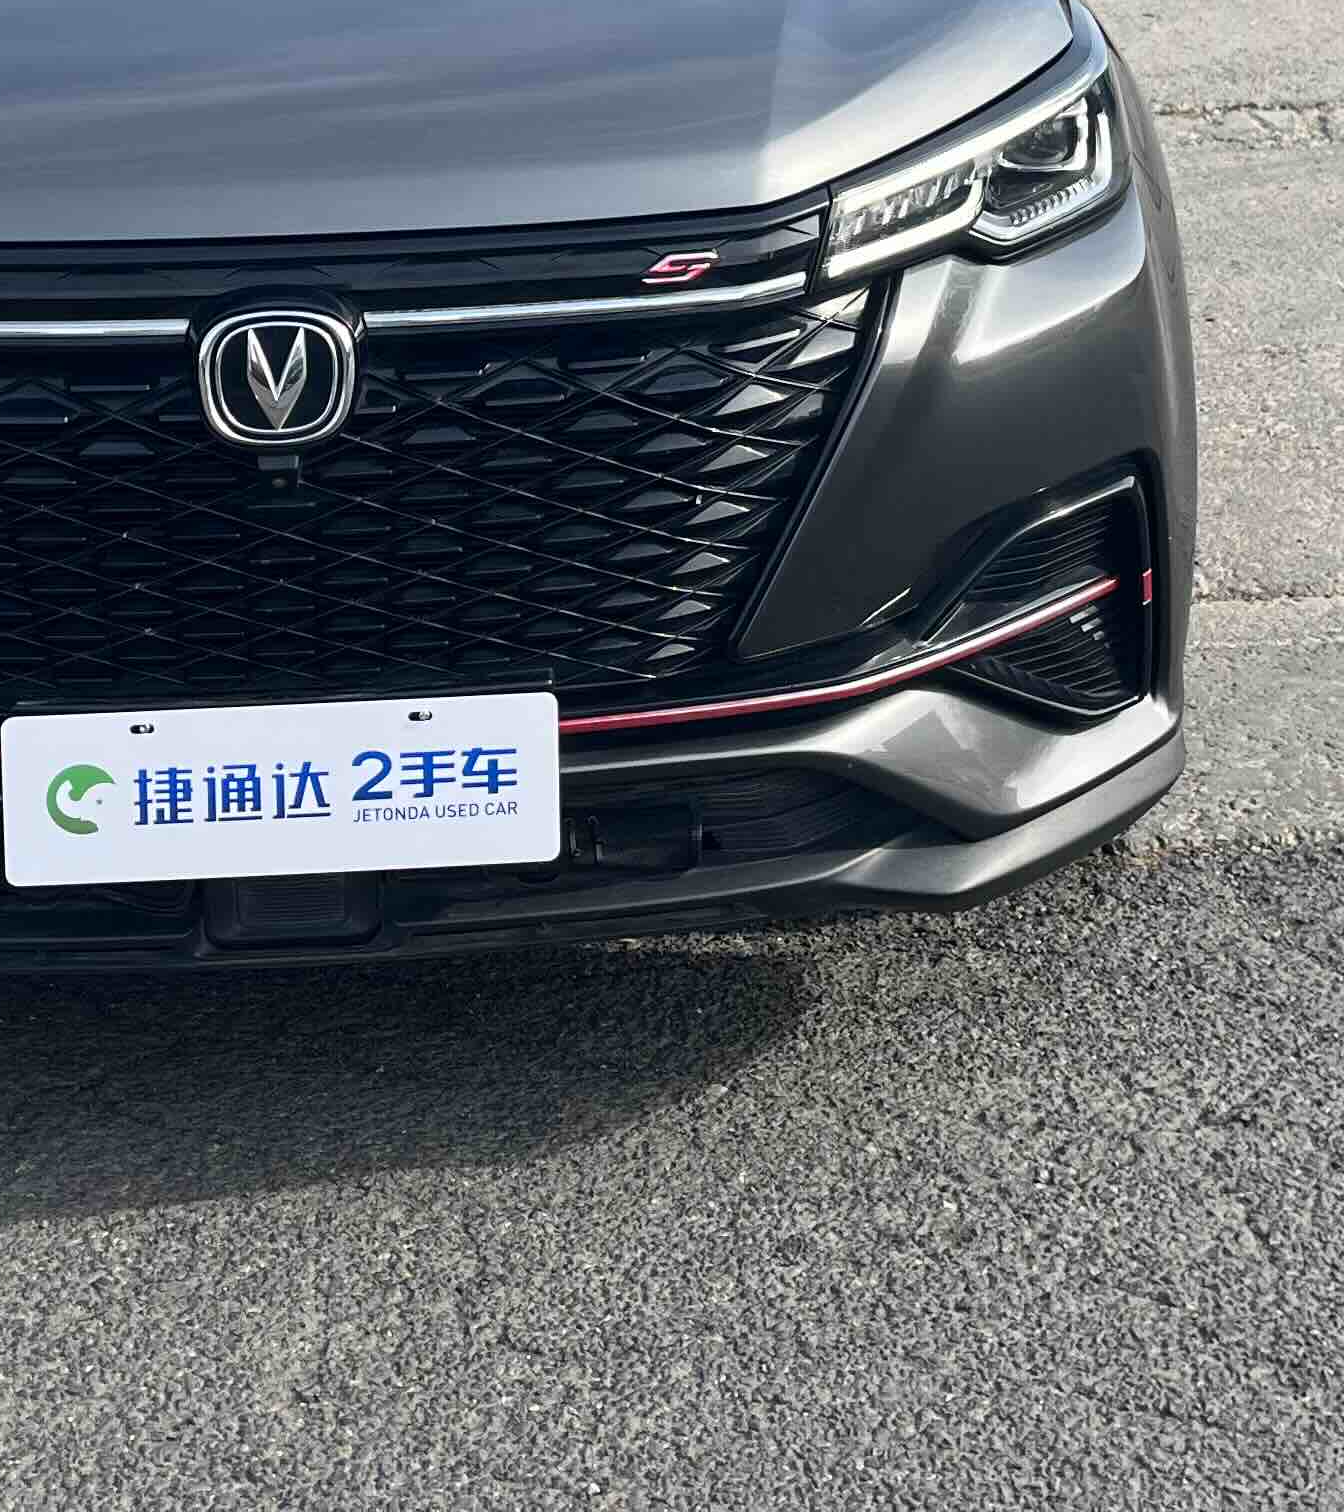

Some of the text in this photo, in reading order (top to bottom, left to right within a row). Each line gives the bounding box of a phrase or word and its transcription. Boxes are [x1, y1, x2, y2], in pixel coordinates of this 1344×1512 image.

[134, 747, 518, 826] 捷通达 2手车
[353, 801, 518, 823] JETONDA USED CAR
